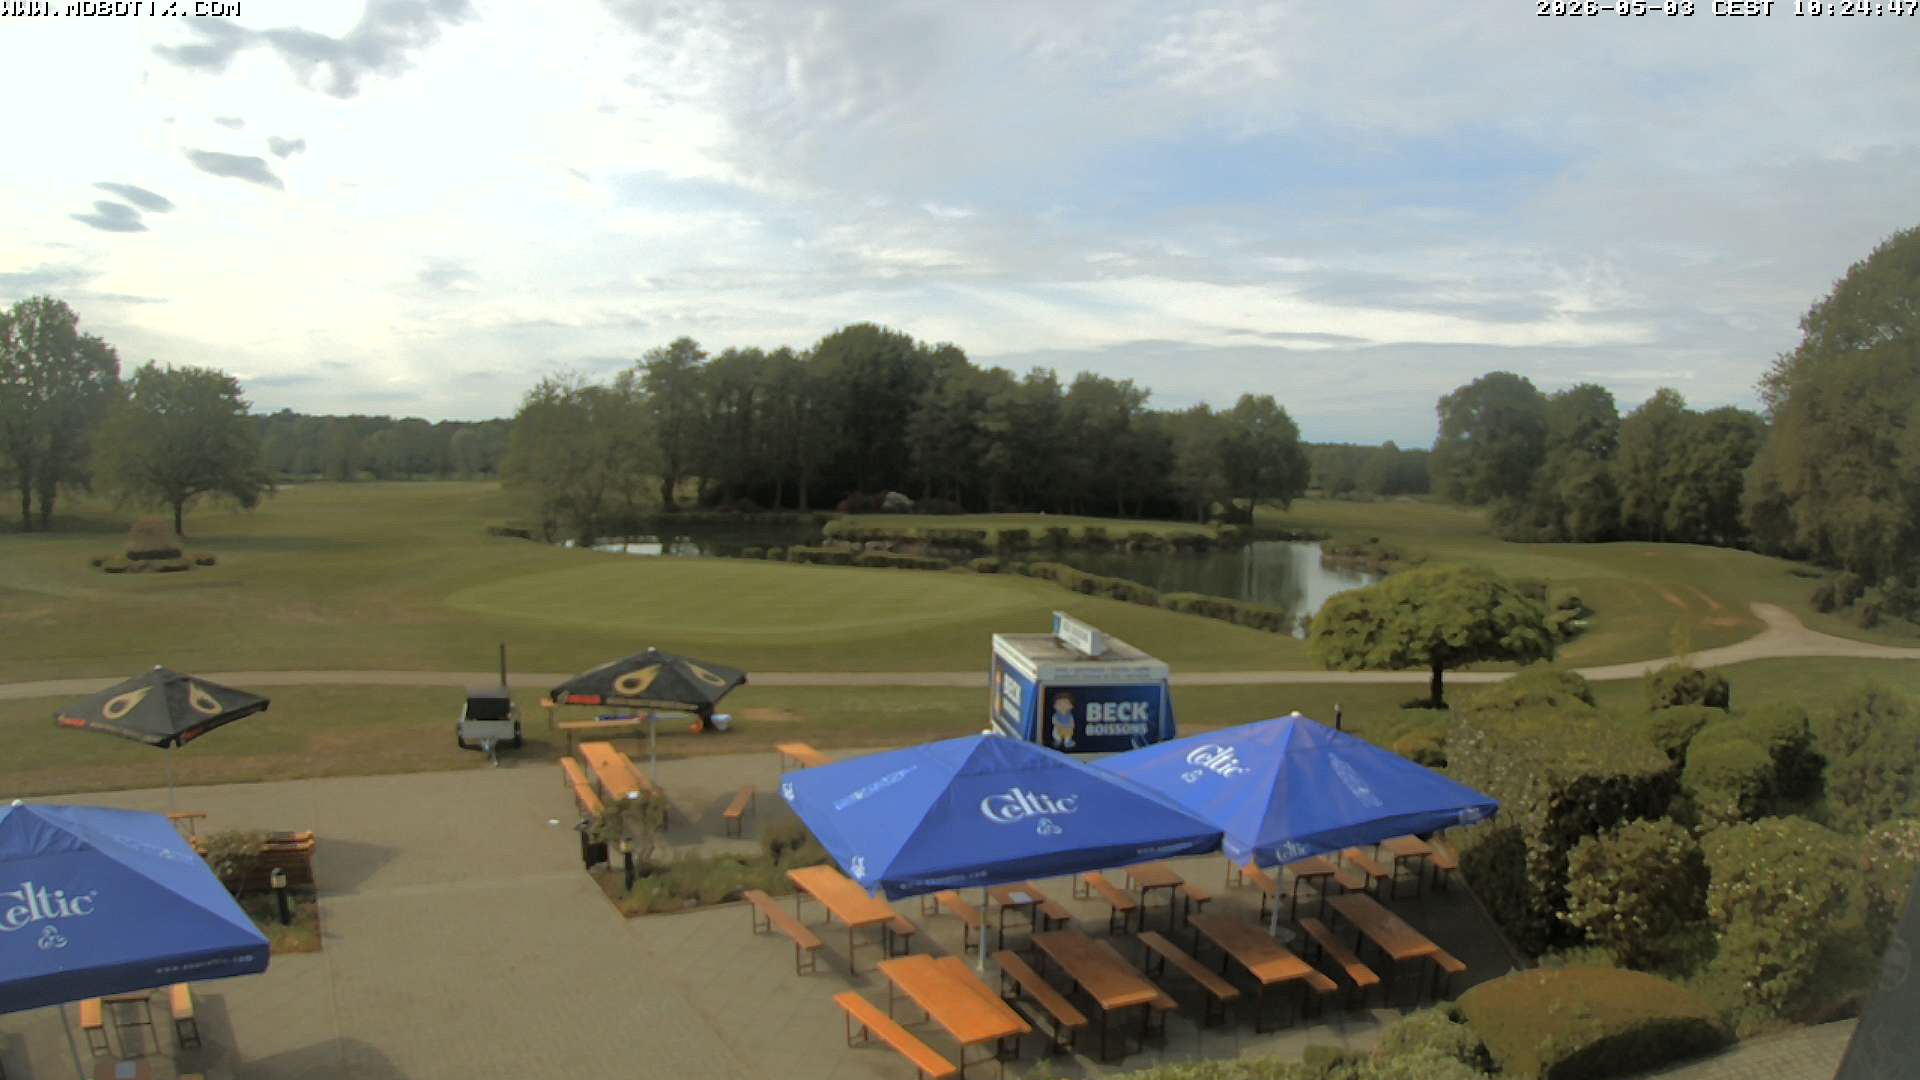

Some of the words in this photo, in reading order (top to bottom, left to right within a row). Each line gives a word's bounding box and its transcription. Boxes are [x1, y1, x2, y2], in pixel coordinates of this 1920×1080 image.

[1086, 702, 1149, 722] BECK
[1085, 723, 1148, 736] BOISSONS
[1185, 744, 1244, 778] Celtic
[980, 787, 1077, 824] Celtic
